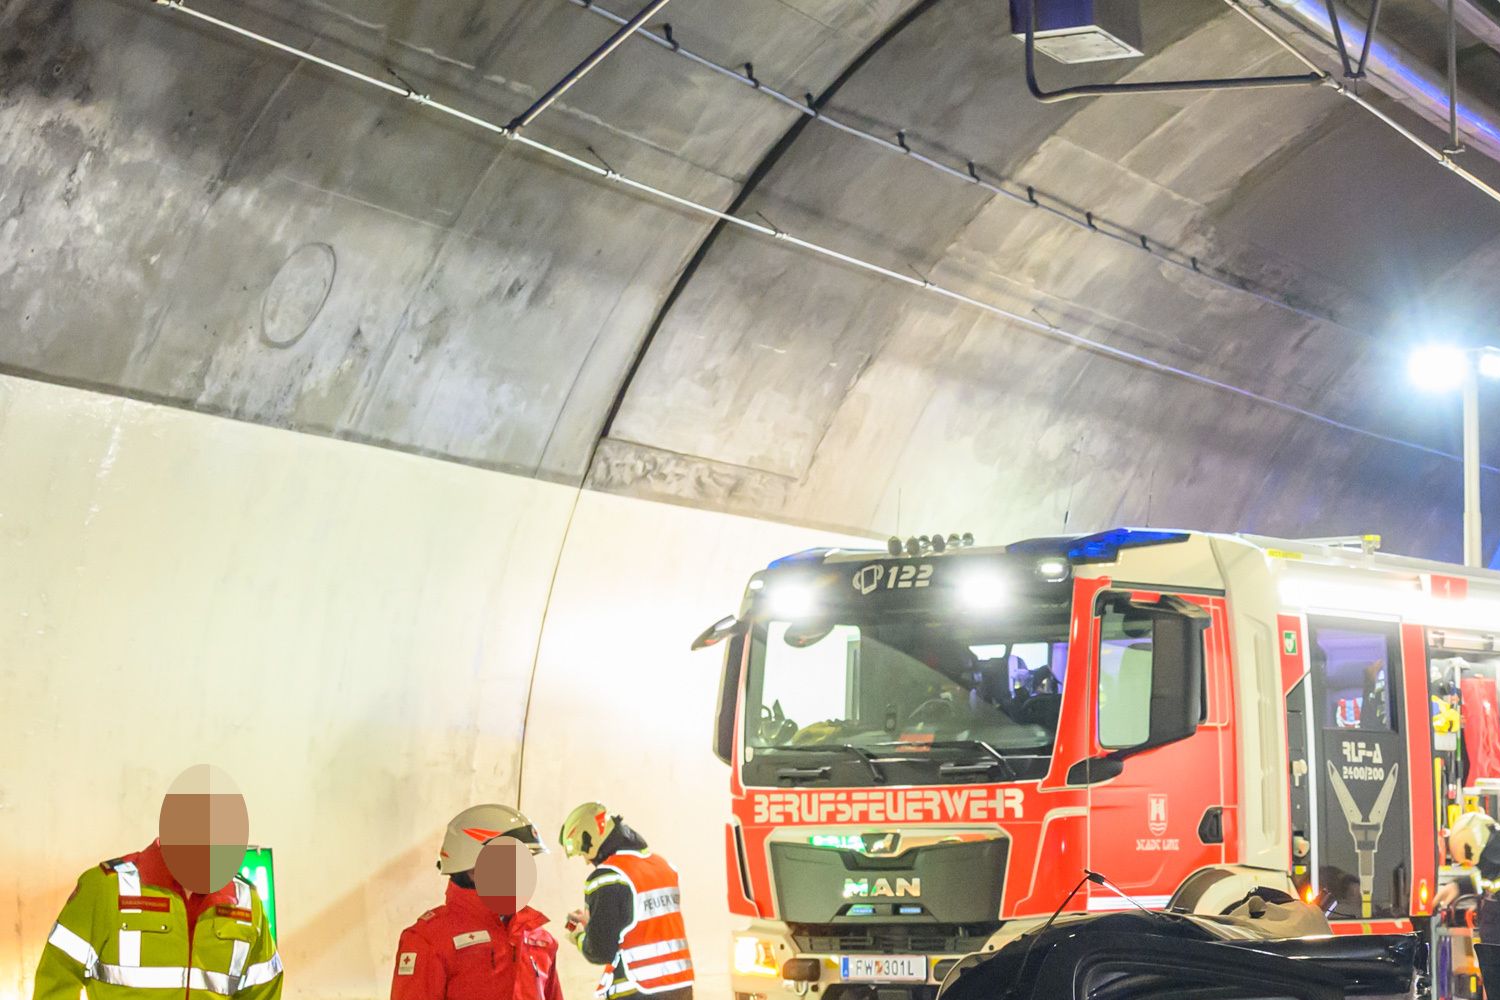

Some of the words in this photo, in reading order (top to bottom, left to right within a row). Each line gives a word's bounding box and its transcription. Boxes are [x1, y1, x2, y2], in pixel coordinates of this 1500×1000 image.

[887, 564, 934, 589] 122
[1342, 741, 1383, 764] RLF-A
[753, 788, 1025, 824] BERUFSFEUERWEHR
[842, 877, 921, 898] MAN
[856, 960, 873, 976] FW
[883, 960, 914, 976] 301L
